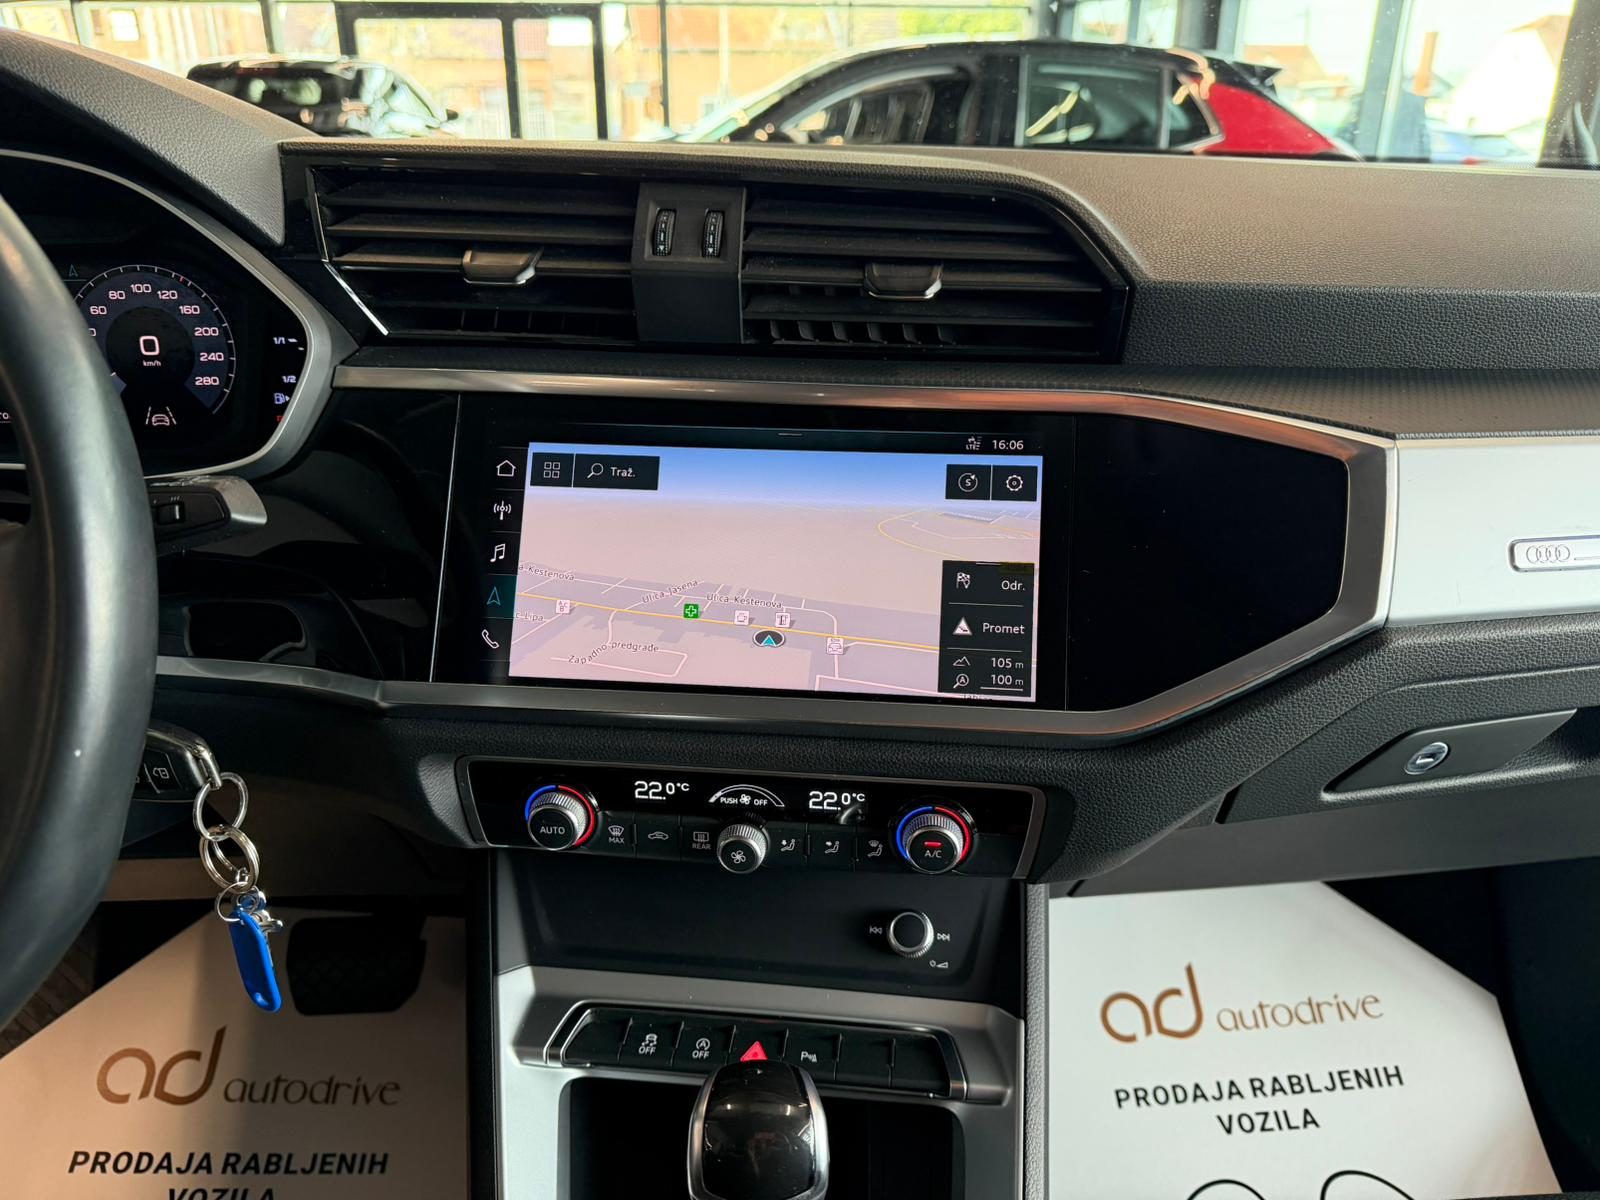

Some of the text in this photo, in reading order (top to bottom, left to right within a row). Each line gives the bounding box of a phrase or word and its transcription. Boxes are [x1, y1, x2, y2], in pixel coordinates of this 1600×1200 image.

[130, 283, 152, 293] 100
[108, 290, 126, 300] 80
[157, 290, 178, 300] 120
[89, 305, 107, 315] 60
[179, 305, 200, 315] 160
[194, 327, 219, 336] 200
[139, 335, 160, 355] 0
[200, 352, 224, 362] 240
[142, 359, 162, 367] km/h
[194, 376, 220, 386] 280
[282, 375, 297, 383] 1/2
[992, 440, 1024, 450] 16:06
[610, 466, 636, 478] Traž.
[528, 565, 575, 581] Kestenova
[1001, 579, 1025, 591] Odr.
[642, 580, 698, 604] Ulica Jasena
[706, 593, 783, 609] Ulica Kestenova
[524, 612, 544, 622] Lipa
[982, 622, 1025, 635] Promet
[568, 644, 608, 664] Zapadno
[991, 657, 1012, 668] 105
[991, 674, 1012, 685] 100
[720, 796, 768, 807] PUSH OFF
[539, 825, 566, 836] AUTO
[608, 836, 625, 845] MAX
[692, 843, 711, 851] REAR
[924, 849, 942, 859] A/C
[1100, 962, 1384, 1043] ad autodrive
[639, 1045, 656, 1055] OFF
[692, 1050, 709, 1060] OFF
[96, 1025, 402, 1107] ad autodrive
[1115, 1065, 1405, 1109] PRODAJA RABLJENIH
[1217, 1108, 1320, 1135] VOZILA
[68, 1151, 389, 1175] PRODAJA RABLJENIH
